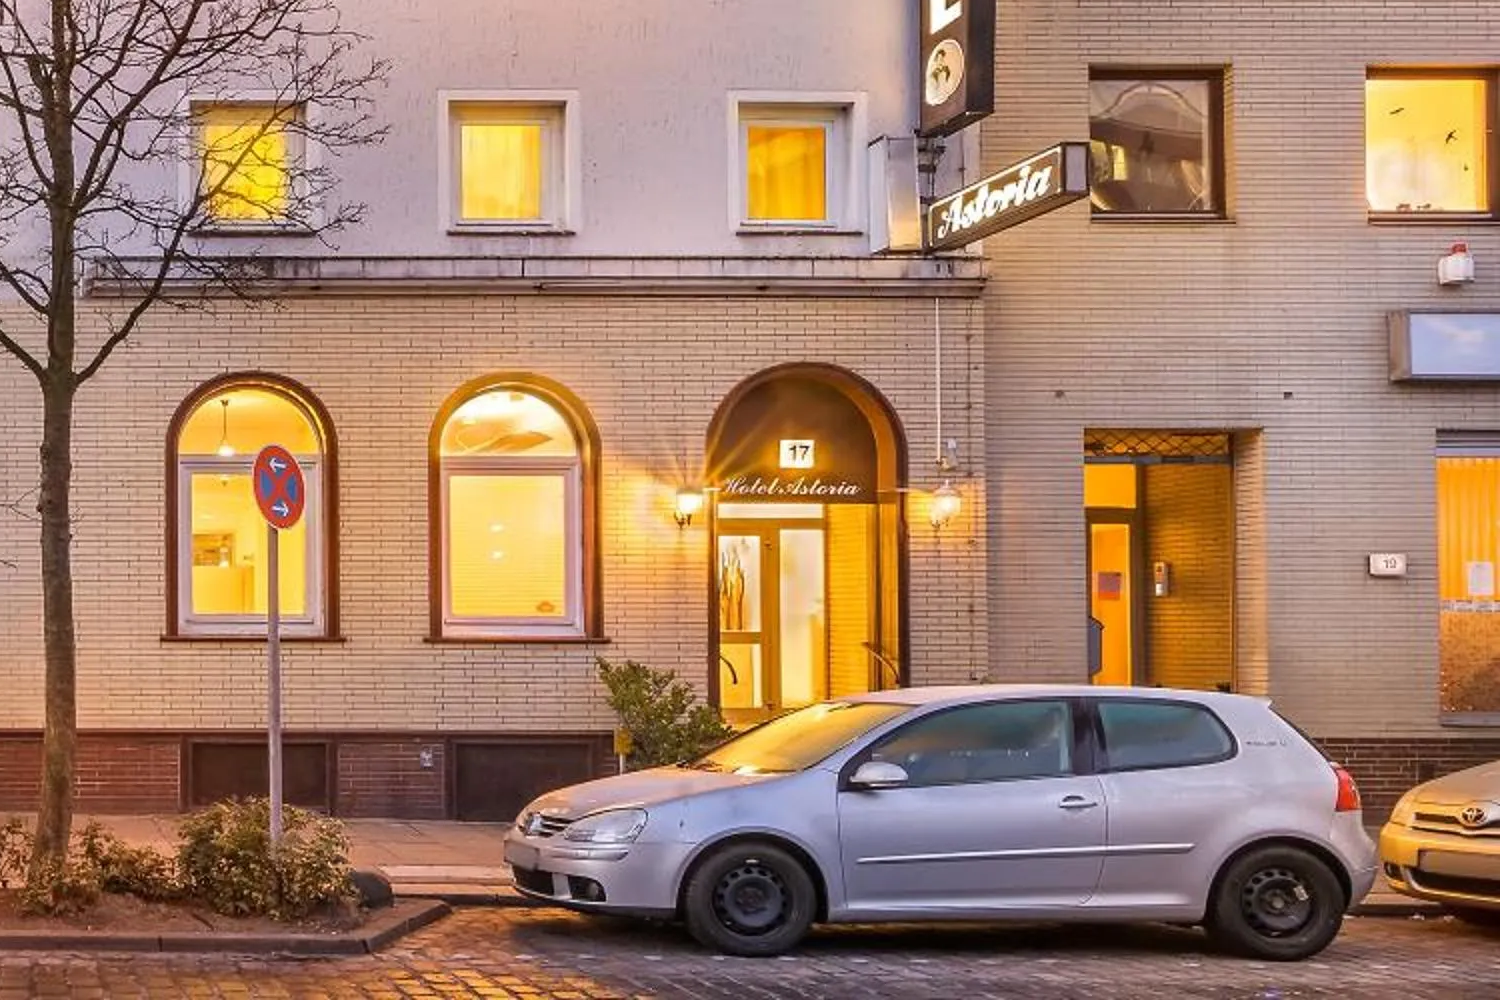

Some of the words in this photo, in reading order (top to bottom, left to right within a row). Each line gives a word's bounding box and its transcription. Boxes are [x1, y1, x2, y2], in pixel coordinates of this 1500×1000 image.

[937, 165, 1053, 239] Astoria
[788, 445, 810, 461] 17
[725, 475, 782, 495] Hotel
[785, 475, 861, 495] Astoria
